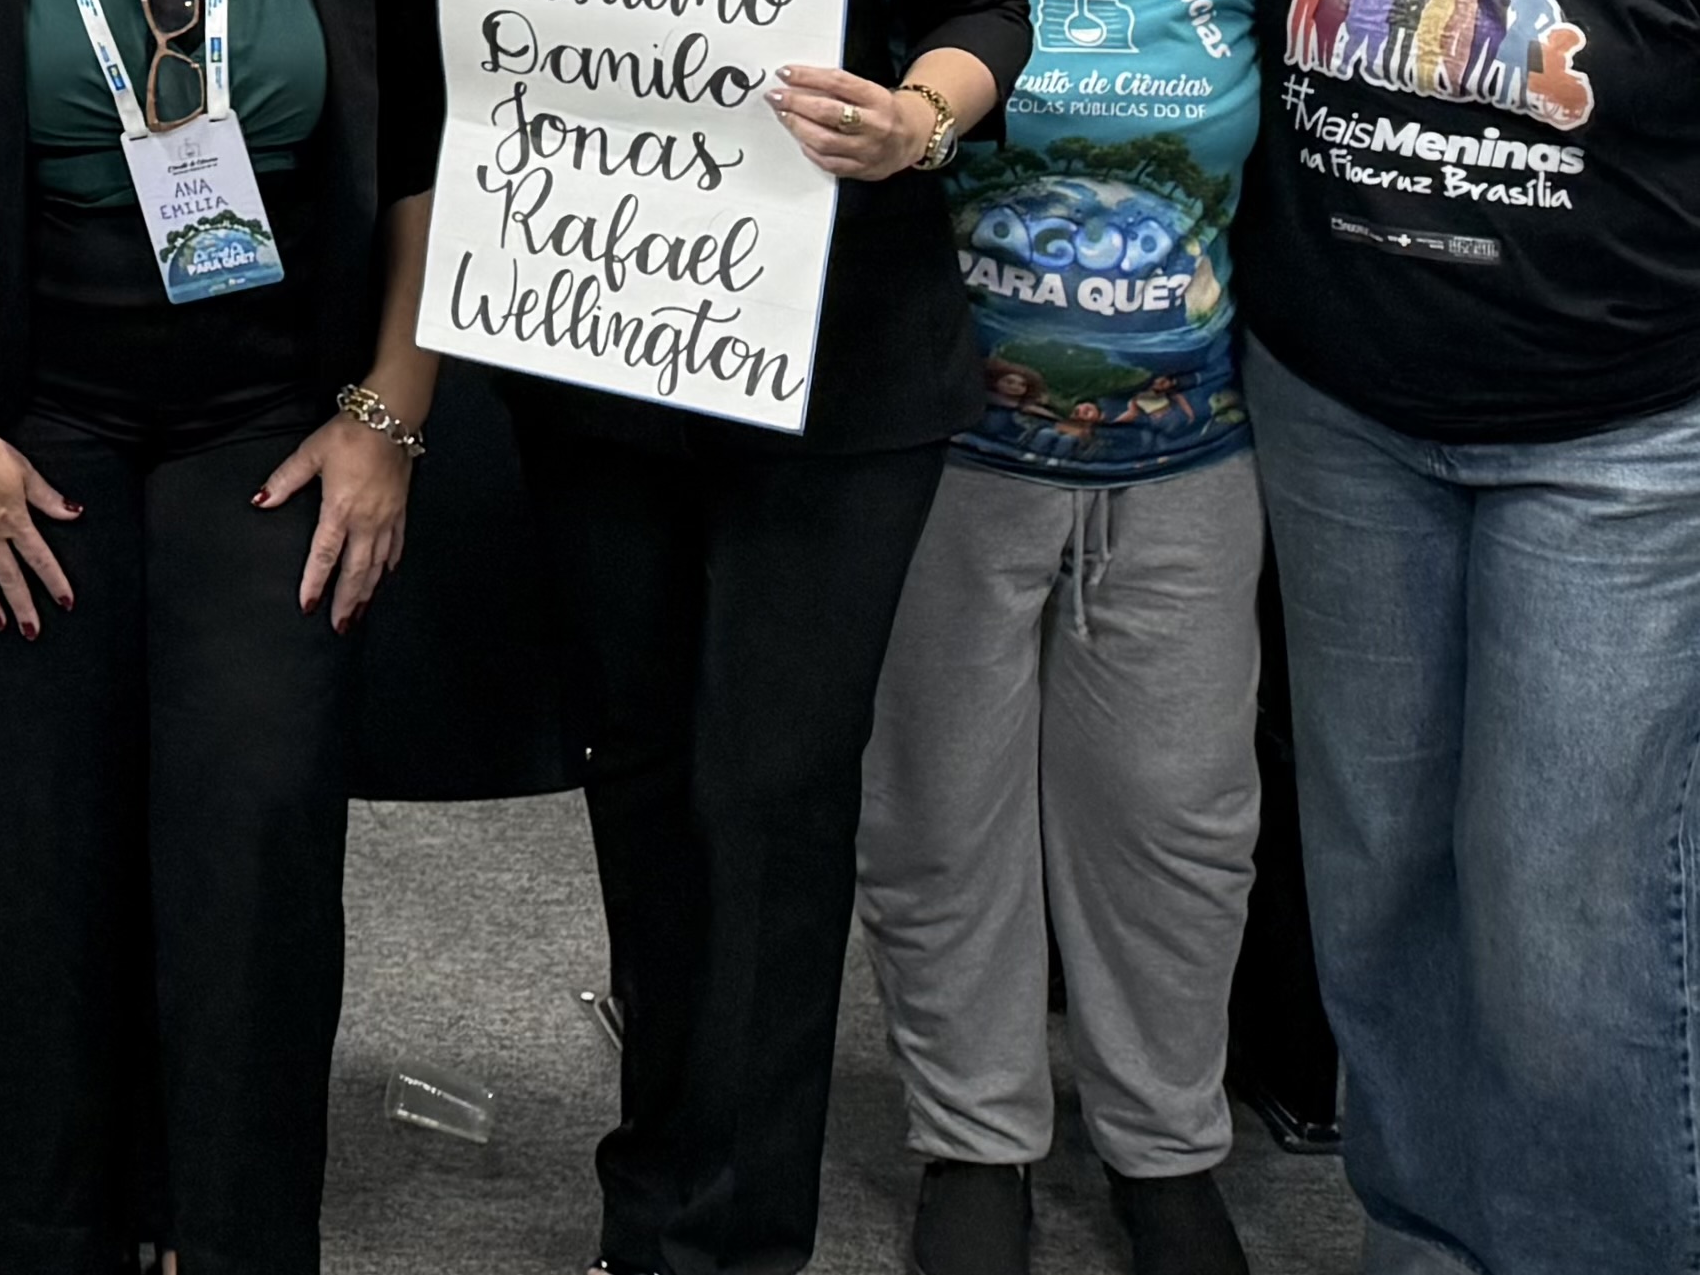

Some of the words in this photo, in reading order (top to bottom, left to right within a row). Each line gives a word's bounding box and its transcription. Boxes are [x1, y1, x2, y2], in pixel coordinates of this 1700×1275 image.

[480, 9, 766, 108] Danilo
[1014, 68, 1074, 93] cuito
[1079, 69, 1111, 94] de
[1115, 72, 1213, 97] Ciências
[491, 81, 744, 191] Jonas
[1006, 97, 1065, 114] COLAS
[1070, 99, 1148, 118] PÚBLICAS
[1154, 104, 1180, 118] DO
[1281, 74, 1585, 174] #MaisMeninas
[160, 196, 229, 219] EMILIA
[175, 178, 213, 198] ANA
[1300, 148, 1325, 174] na
[1330, 148, 1432, 194] Fiocruz
[1441, 164, 1573, 210] Brasília
[477, 164, 764, 292] Rafael
[450, 251, 805, 402] Wellington
